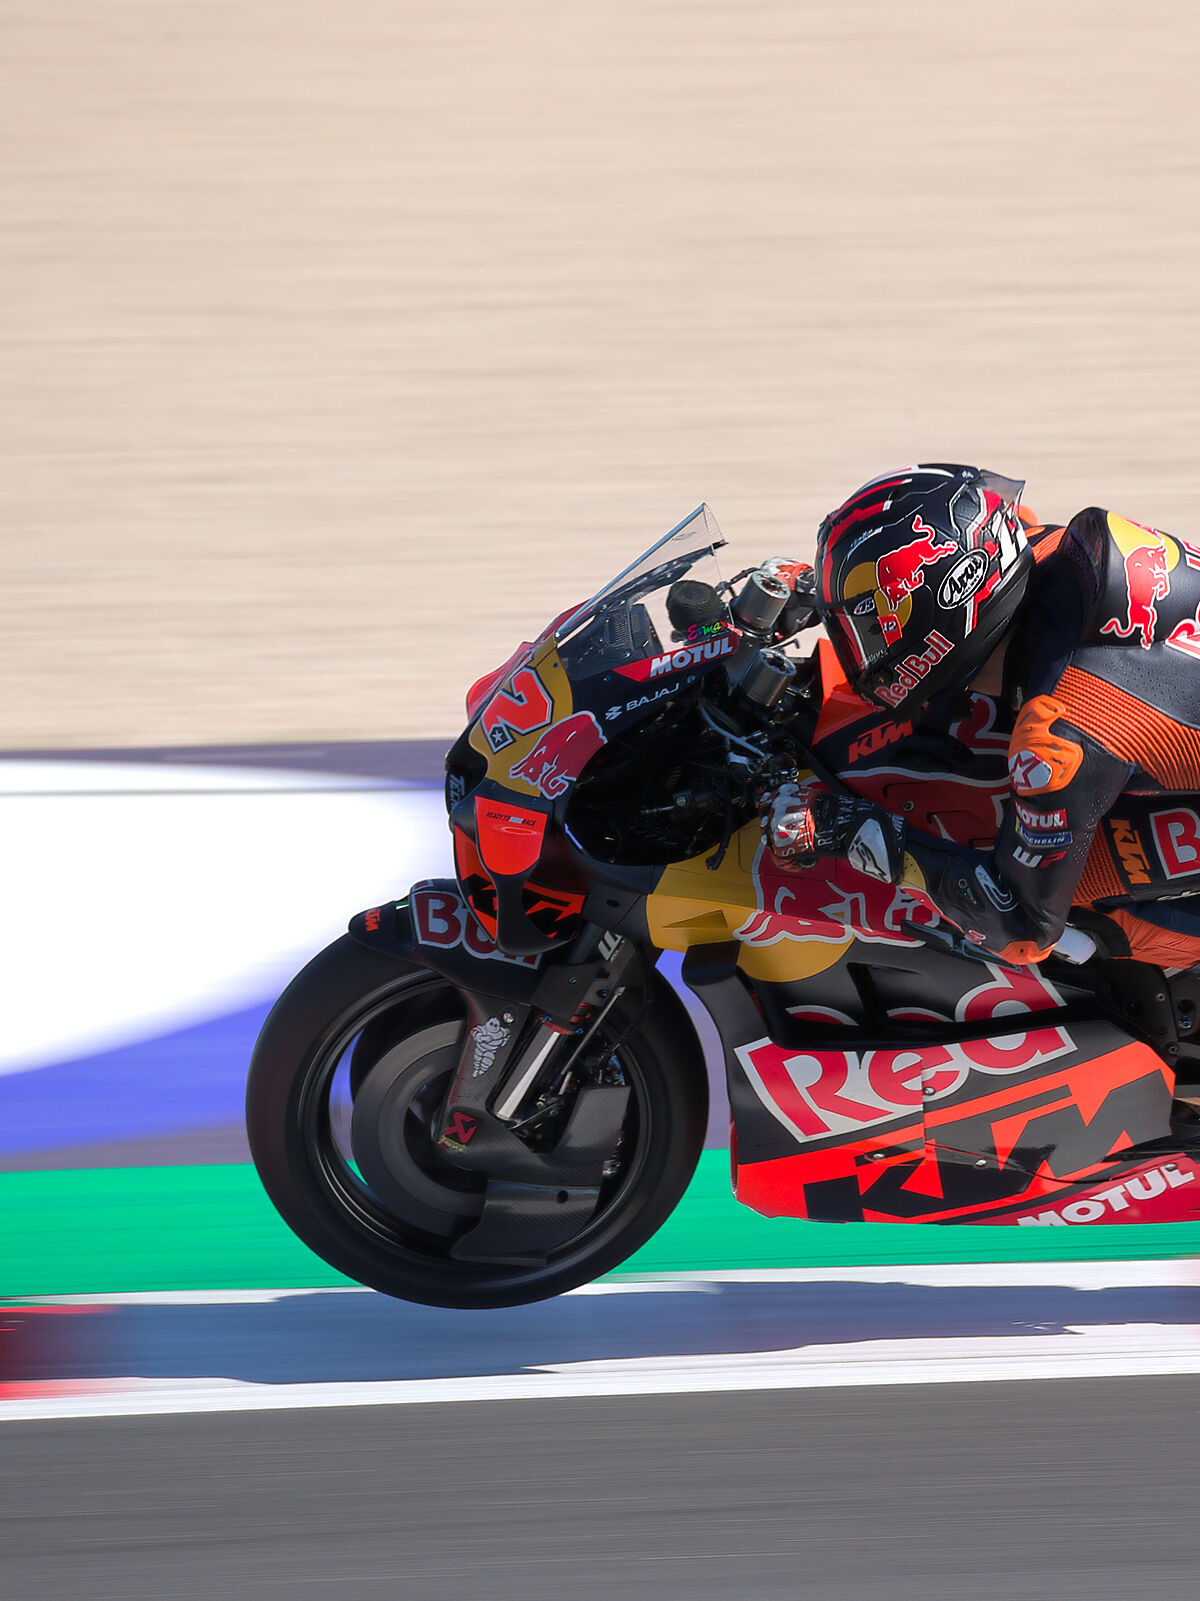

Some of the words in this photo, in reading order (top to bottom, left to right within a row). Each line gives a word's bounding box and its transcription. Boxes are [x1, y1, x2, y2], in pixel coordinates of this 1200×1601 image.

[649, 637, 733, 678] MOTUL
[902, 629, 955, 679] Bull
[626, 683, 680, 711] BAJAJ
[848, 720, 914, 764] KTM
[1109, 819, 1152, 885] KTM
[733, 960, 1078, 1143] Red
[803, 1069, 1174, 1223] KTM
